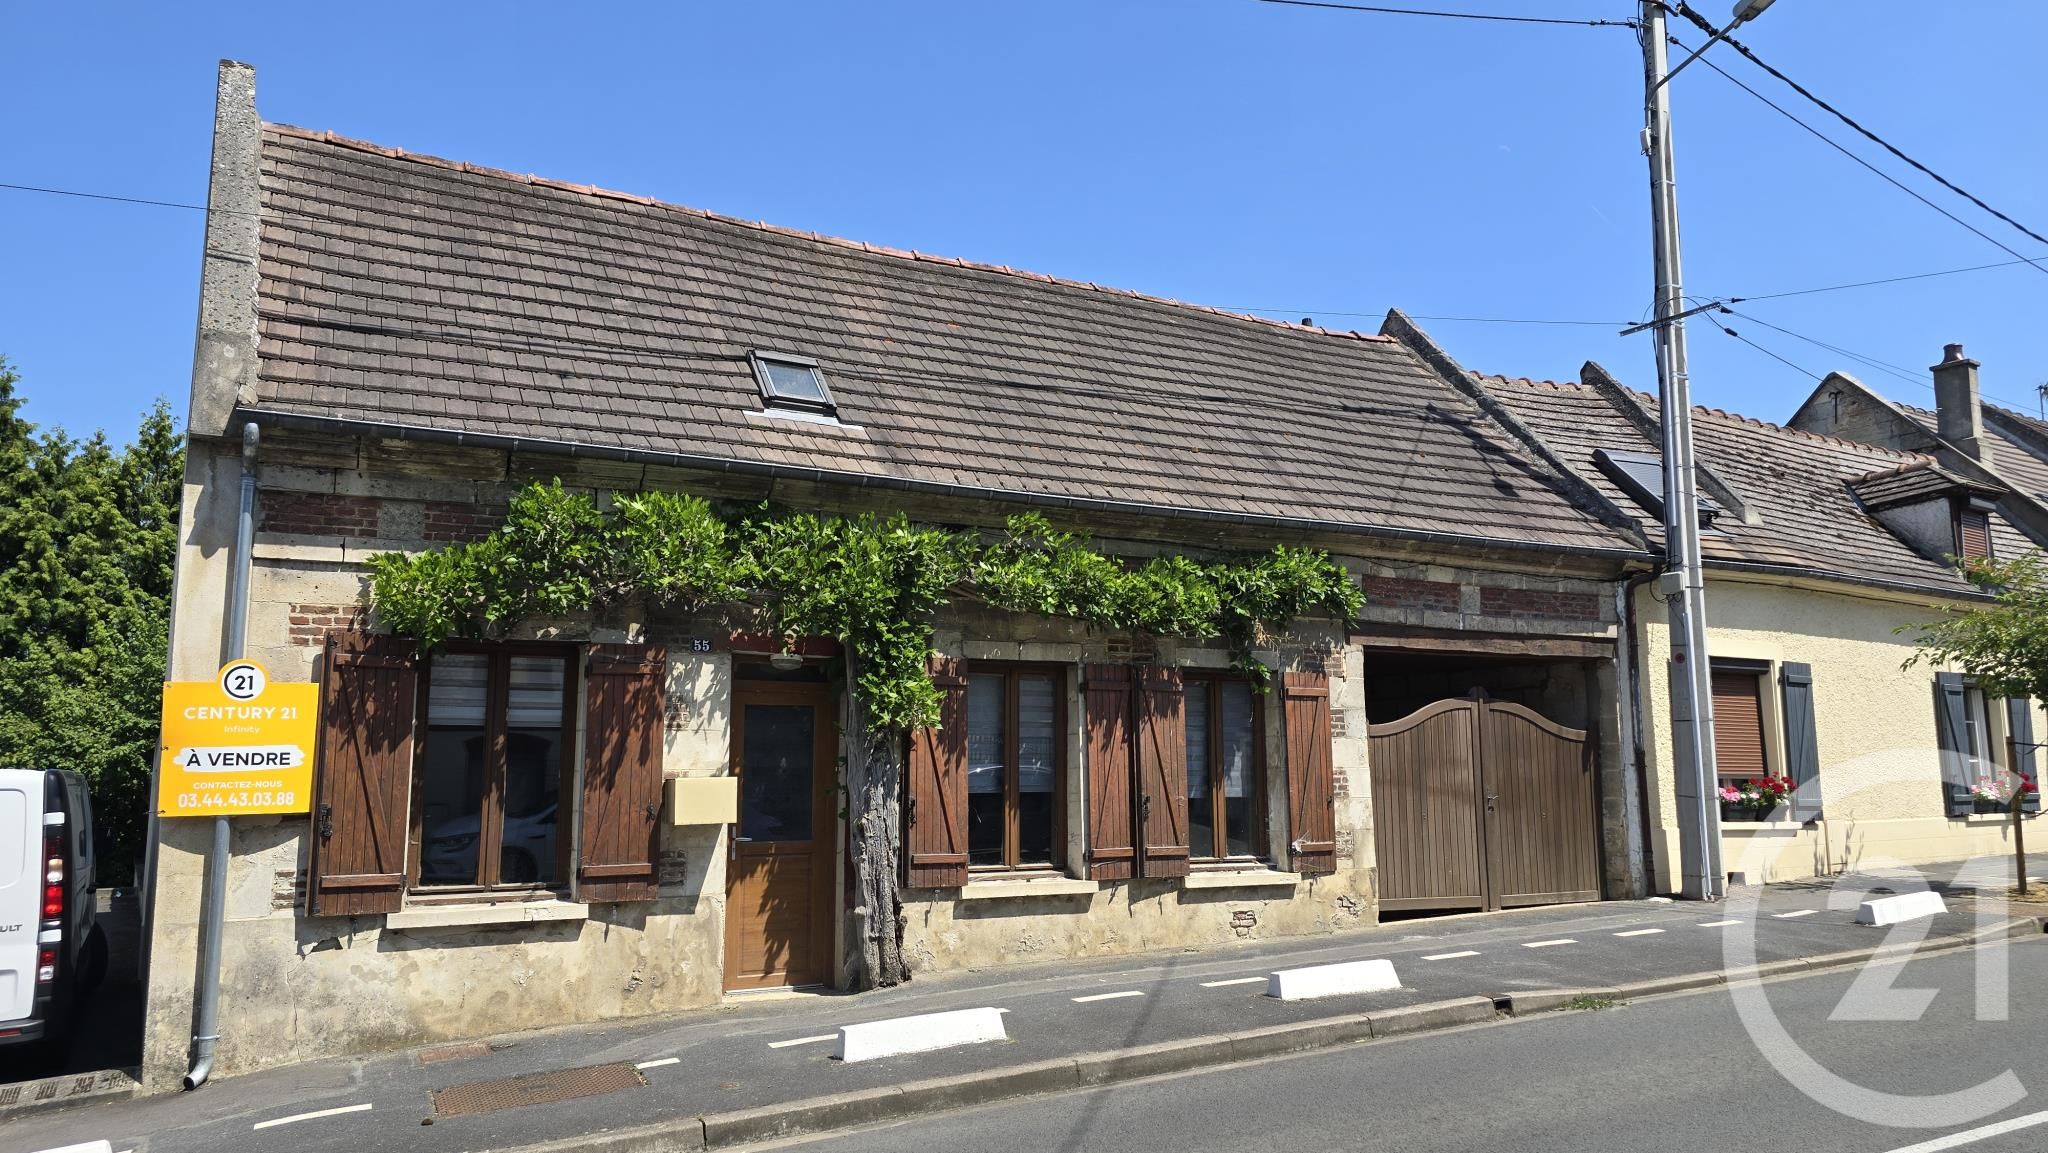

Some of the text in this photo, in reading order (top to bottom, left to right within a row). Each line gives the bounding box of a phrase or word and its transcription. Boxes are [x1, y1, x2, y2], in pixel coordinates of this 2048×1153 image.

[693, 639, 710, 651] 55
[234, 675, 254, 690] 21
[184, 706, 297, 720] CENTURY 21
[187, 749, 291, 766] À VENDRE
[193, 780, 282, 789] CONTACTEZ-NOUS
[178, 792, 295, 808] 03.44.43.03.88
